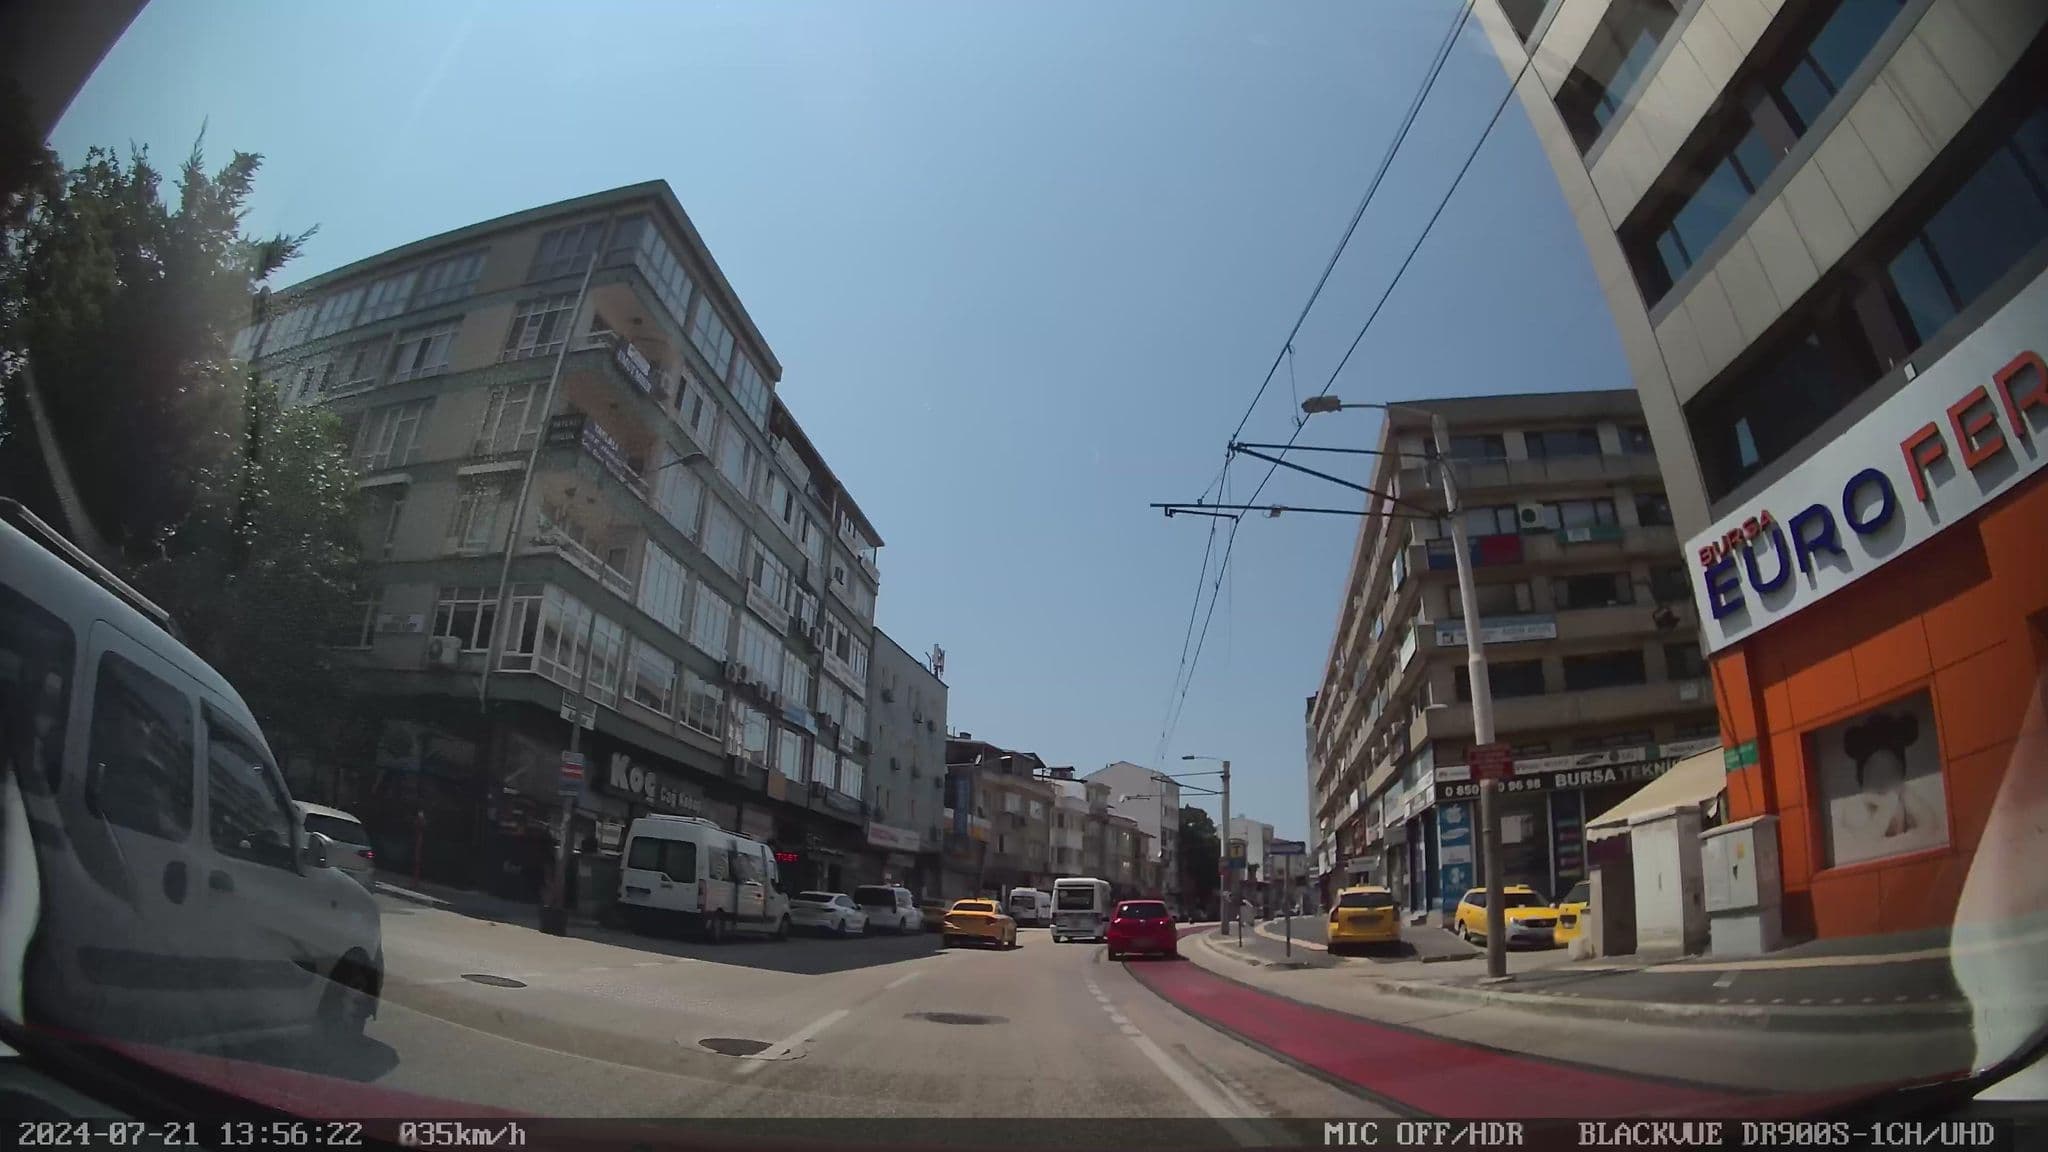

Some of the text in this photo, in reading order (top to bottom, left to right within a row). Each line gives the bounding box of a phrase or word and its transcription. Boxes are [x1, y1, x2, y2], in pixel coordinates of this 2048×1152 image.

[1698, 508, 1775, 568] BURSA
[1704, 467, 1896, 620] EURO
[610, 753, 657, 803] Koç
[1445, 786, 1454, 797] 0
[1456, 784, 1480, 796] 850
[1554, 767, 1617, 788] BURSA
